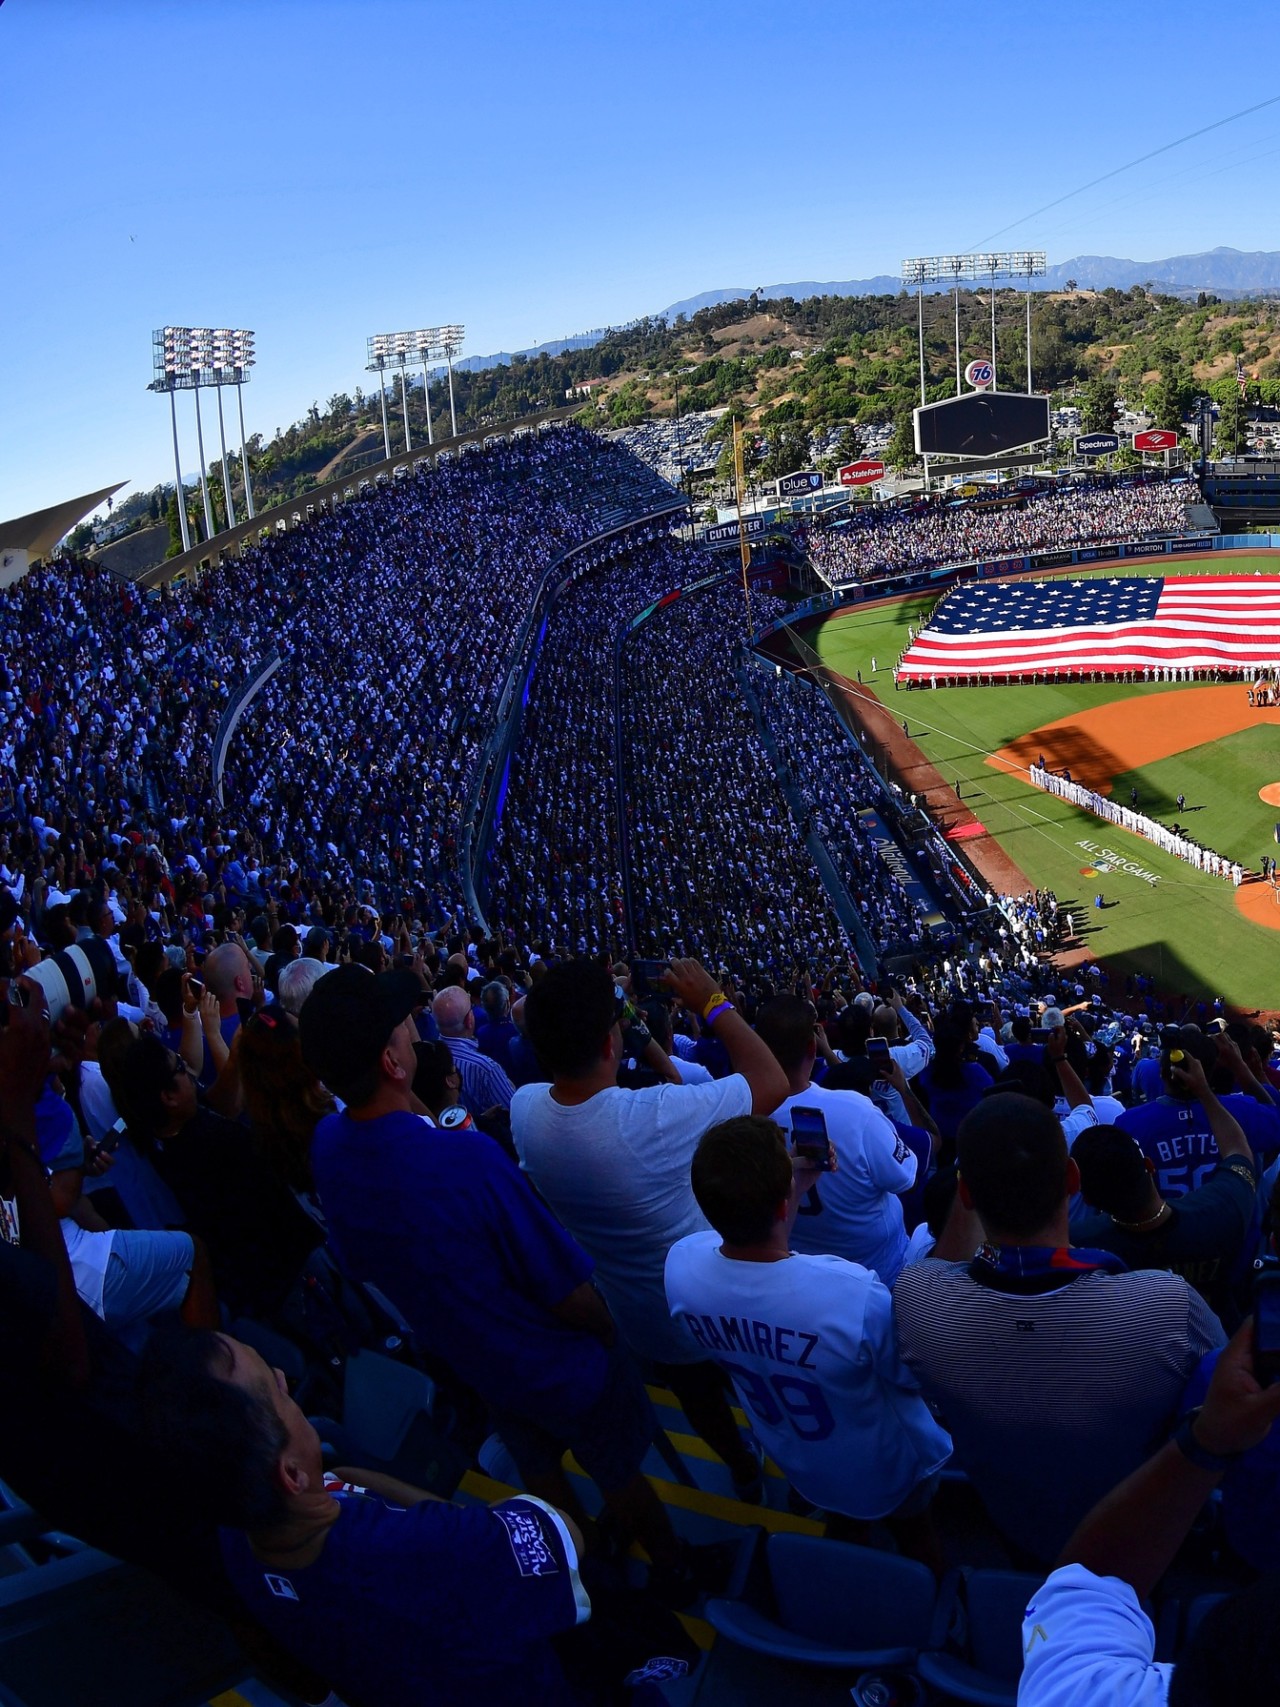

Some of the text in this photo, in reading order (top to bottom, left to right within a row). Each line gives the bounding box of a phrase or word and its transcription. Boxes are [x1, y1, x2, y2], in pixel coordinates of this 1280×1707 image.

[973, 366, 991, 380] 76
[1079, 440, 1113, 450] Spectrum
[783, 477, 808, 490] blue
[1134, 545, 1163, 553] MORTON
[875, 837, 920, 887] National
[1074, 840, 1162, 885] ALL STAR GAME
[1156, 1133, 1219, 1162] BETTS
[684, 1313, 819, 1370] RAMIREZ
[522, 1517, 547, 1564] GAME
